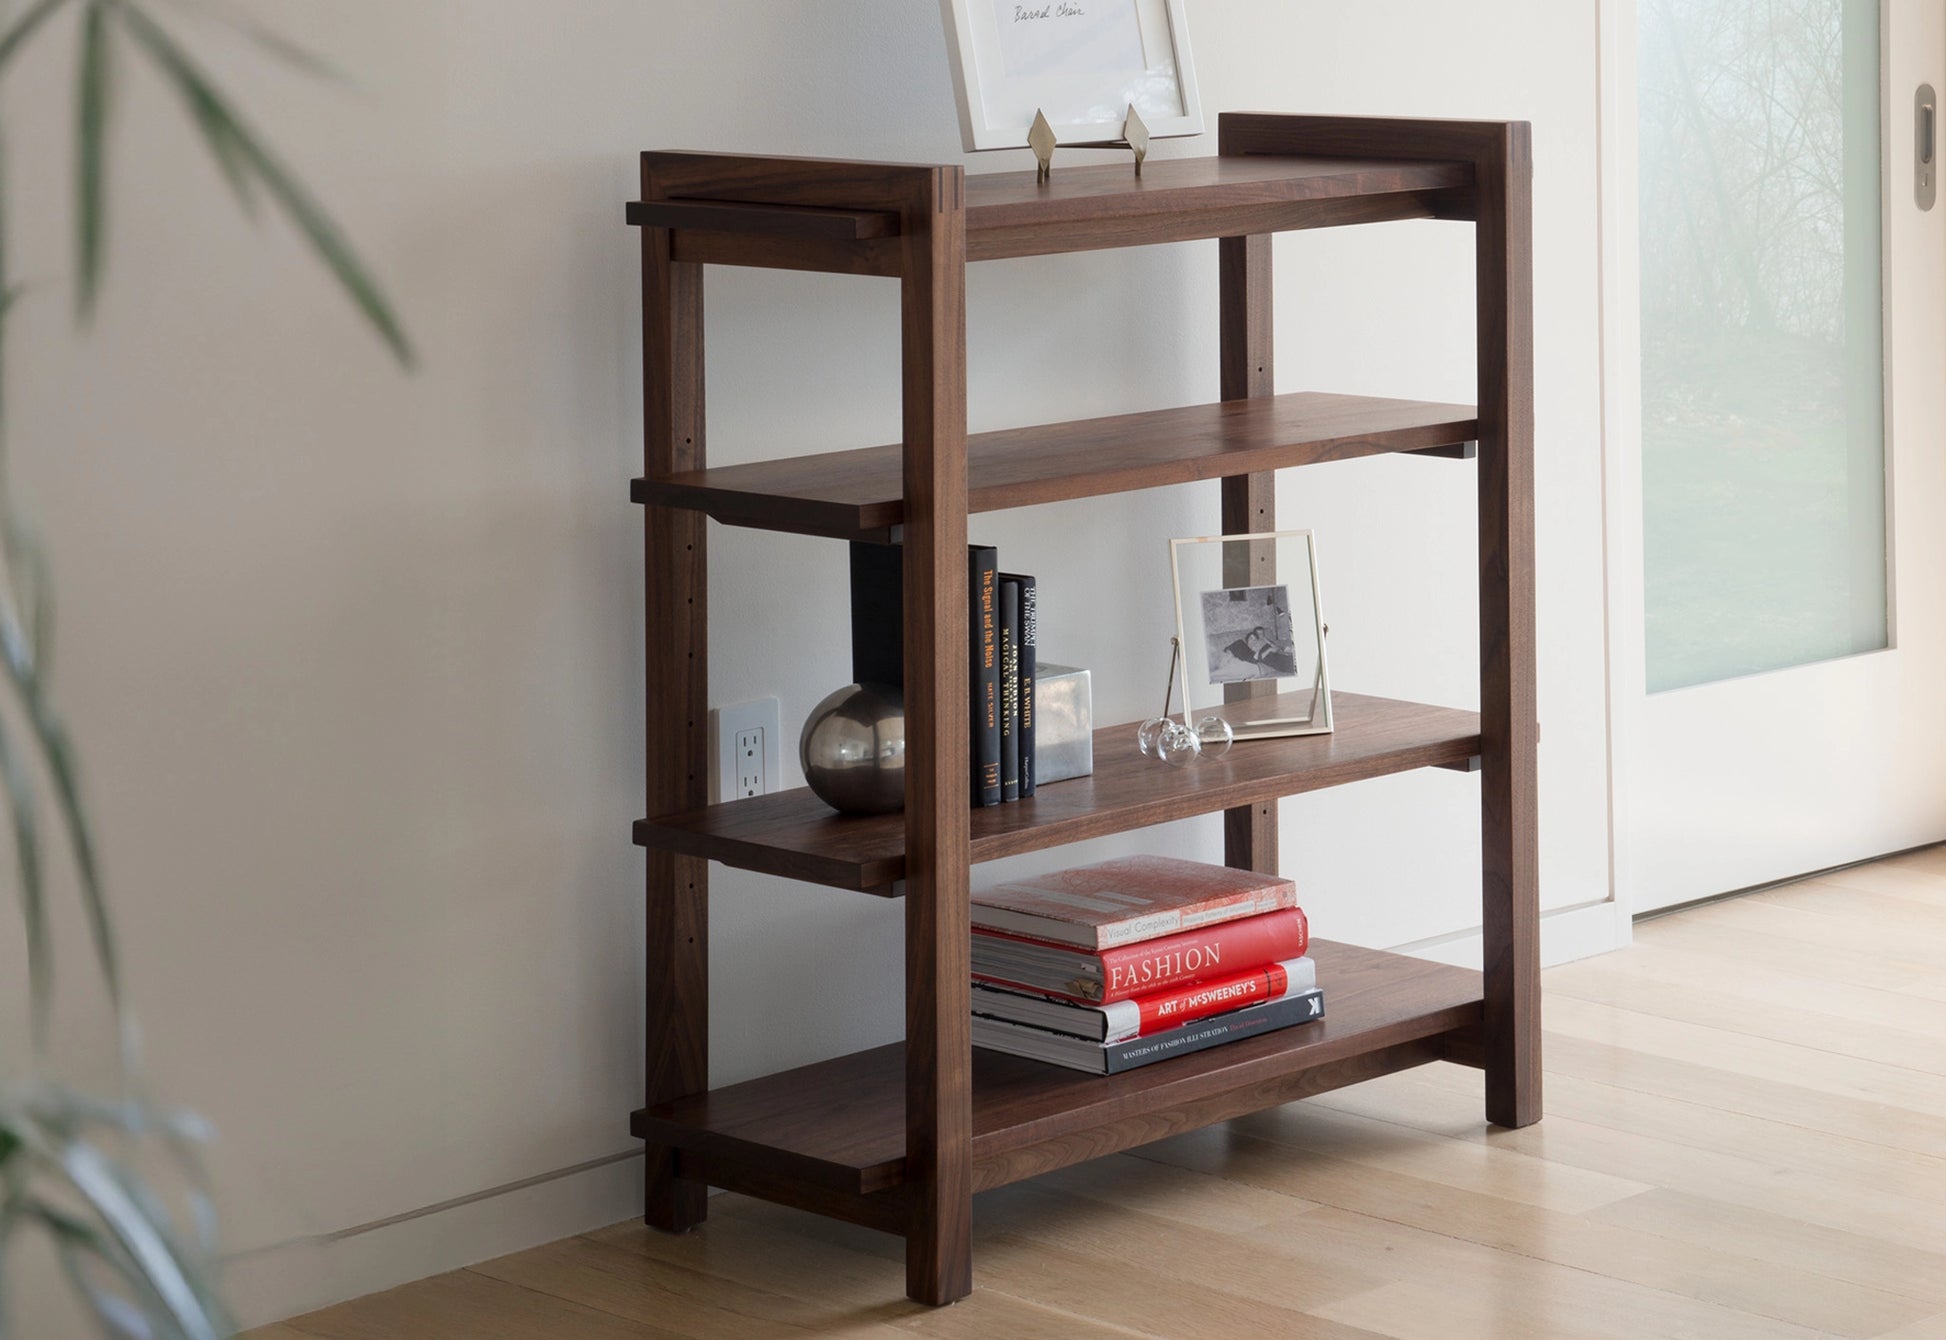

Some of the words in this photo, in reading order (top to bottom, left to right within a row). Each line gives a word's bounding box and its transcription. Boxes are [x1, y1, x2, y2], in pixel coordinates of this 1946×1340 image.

[983, 569, 993, 585] The
[982, 587, 993, 612] Signal
[984, 614, 993, 629] and
[984, 631, 993, 643] the
[985, 645, 994, 668] Noise
[1024, 697, 1032, 728] WHITE
[1108, 926, 1131, 939] Visual
[1134, 916, 1178, 933] Complexity
[1111, 943, 1220, 990] FASHION
[1158, 1000, 1178, 1016] ART
[1180, 998, 1187, 1012] of
[1188, 980, 1257, 1008] McSWEENEY'S
[1123, 1047, 1150, 1060] MASTERS
[1151, 1043, 1160, 1052] OF
[1161, 1037, 1186, 1049] FASHION
[1187, 1026, 1229, 1043] ILLUSTRATION
